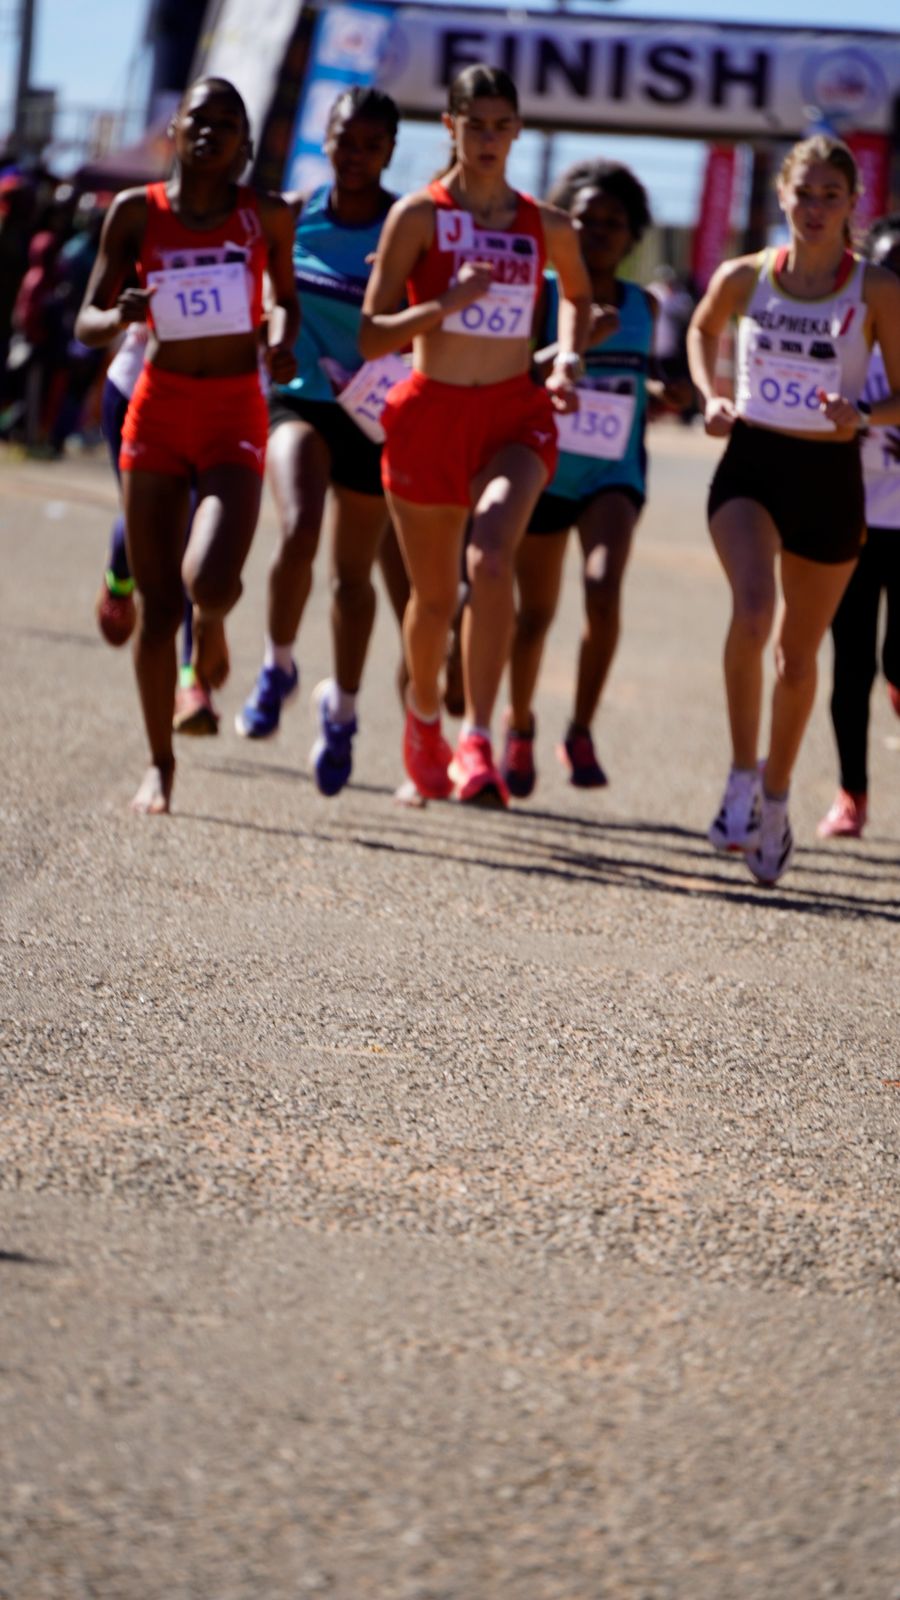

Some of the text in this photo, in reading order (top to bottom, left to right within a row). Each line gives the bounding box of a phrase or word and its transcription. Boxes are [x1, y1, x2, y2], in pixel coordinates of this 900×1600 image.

[438, 30, 771, 108] FINISH
[446, 217, 462, 242] J
[176, 288, 222, 317] 151
[461, 303, 523, 332] 067
[760, 378, 822, 410] 056
